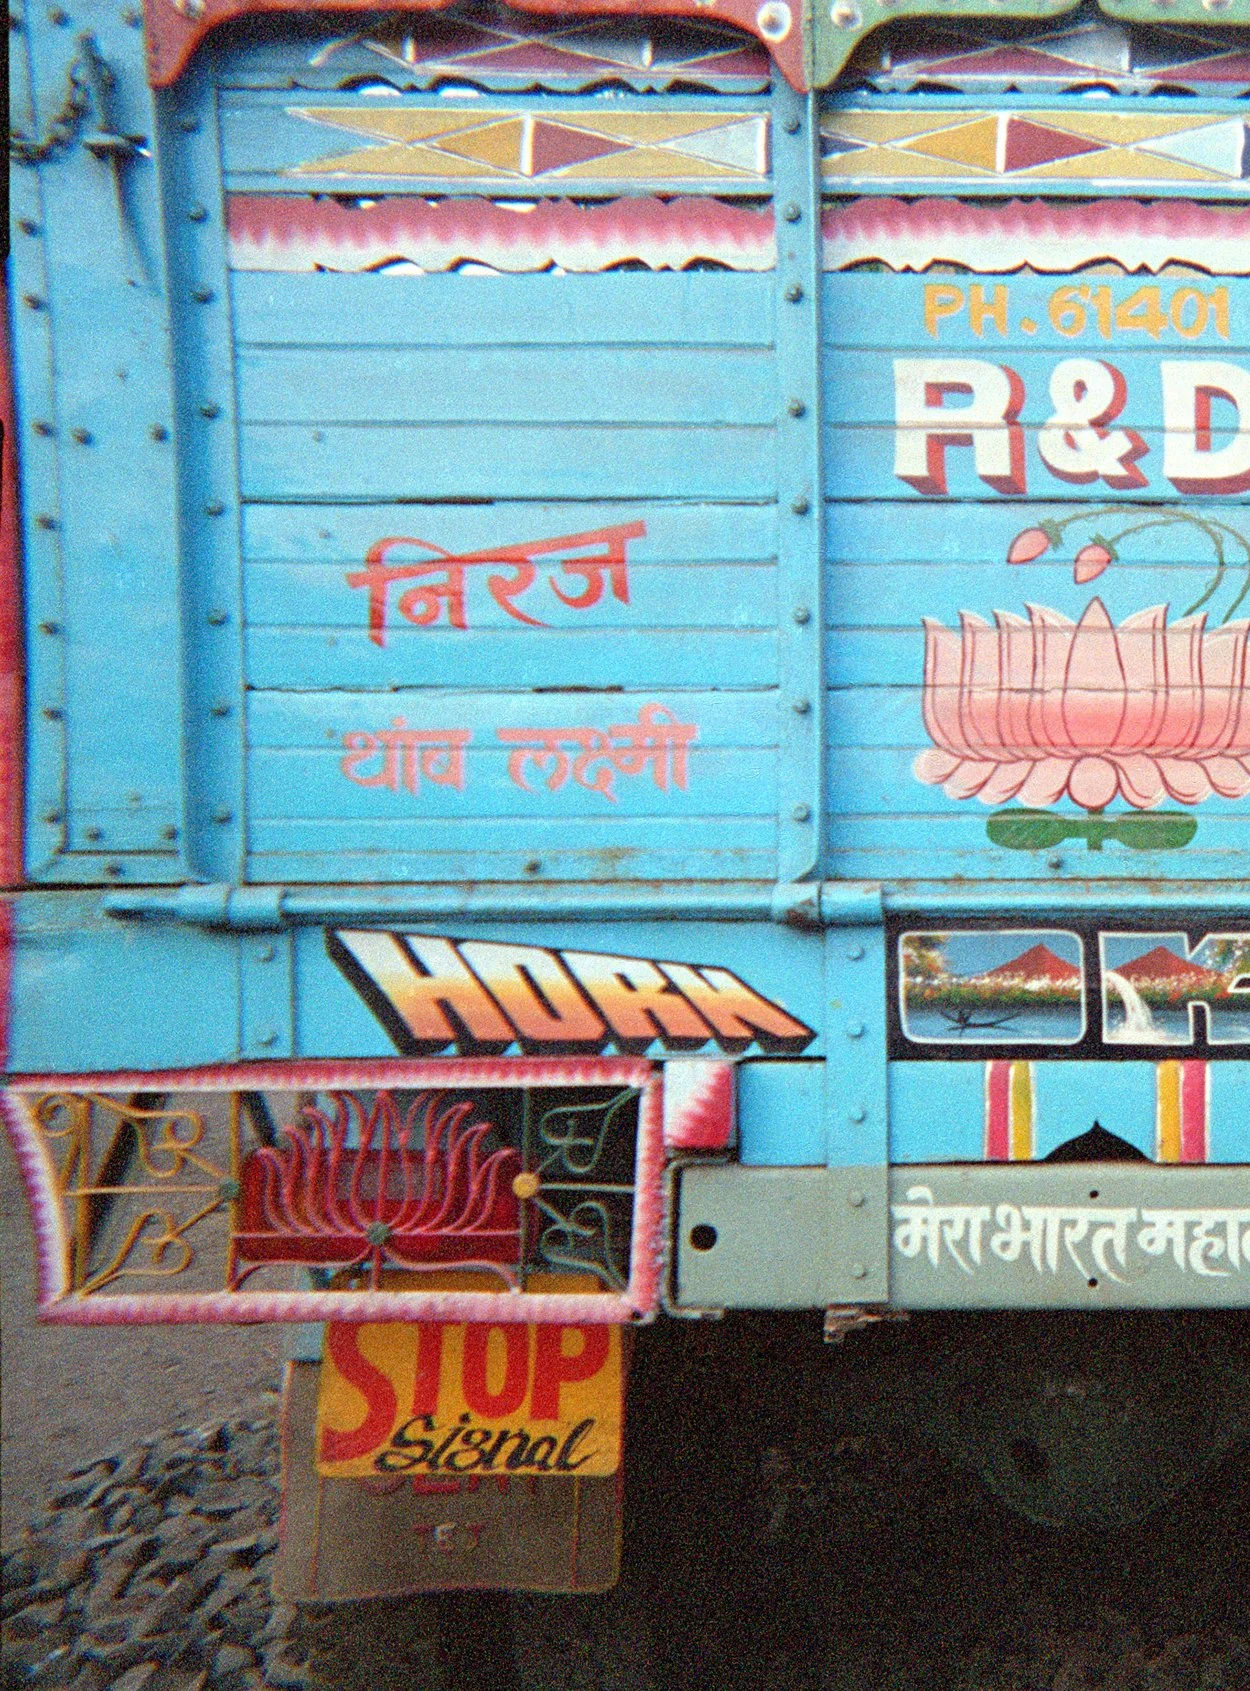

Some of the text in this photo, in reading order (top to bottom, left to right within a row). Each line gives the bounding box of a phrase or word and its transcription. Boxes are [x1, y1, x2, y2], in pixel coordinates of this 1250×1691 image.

[345, 519, 648, 648] निरज
[324, 925, 818, 1056] HORN
[891, 1185, 991, 1276] मेरा
[990, 1203, 1138, 1285] भारत
[320, 1321, 611, 1463] STOP
[373, 1412, 600, 1473] Signal
